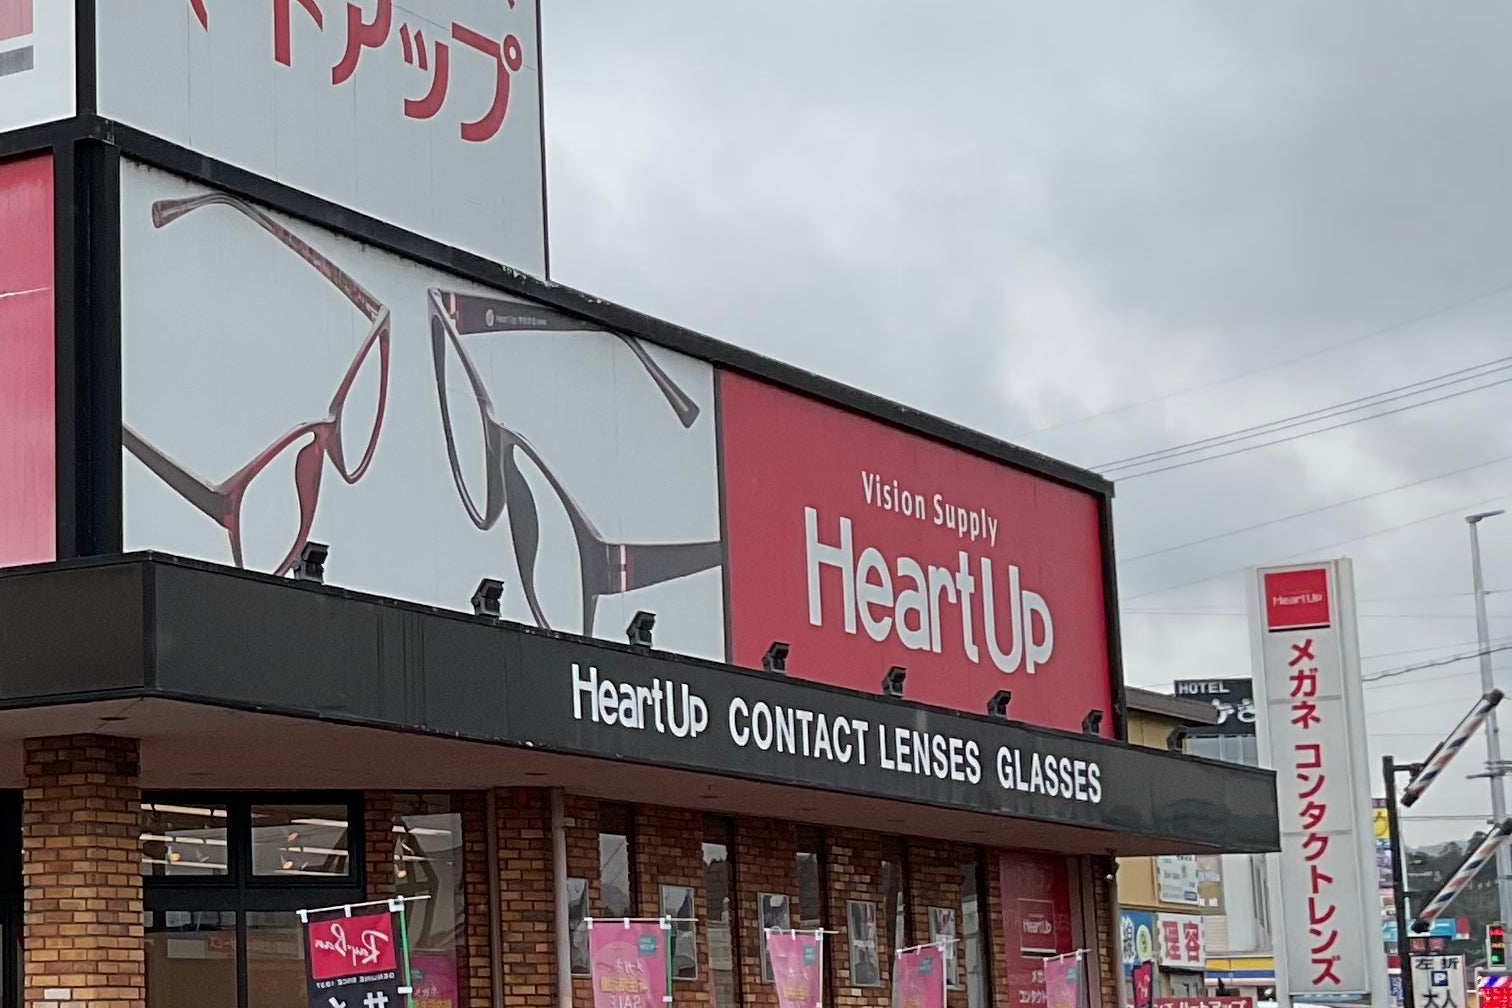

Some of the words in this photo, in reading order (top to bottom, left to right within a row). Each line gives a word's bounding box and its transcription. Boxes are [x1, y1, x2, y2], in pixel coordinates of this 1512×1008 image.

[189, 0, 522, 142] トアップ
[861, 471, 926, 520] Vision
[934, 494, 998, 548] Supply
[804, 507, 1054, 674] HeartUp
[1273, 592, 1323, 607] HeartUp
[1178, 681, 1230, 695] HOTEL
[1288, 638, 1322, 730] メガネ
[571, 663, 708, 738] HeartUp
[728, 697, 869, 765] CONTACT
[879, 725, 981, 785] LENSES
[996, 747, 1101, 804] GLASSES
[1294, 743, 1341, 986] コンタクトレンズ
[1414, 957, 1459, 970] 左折
